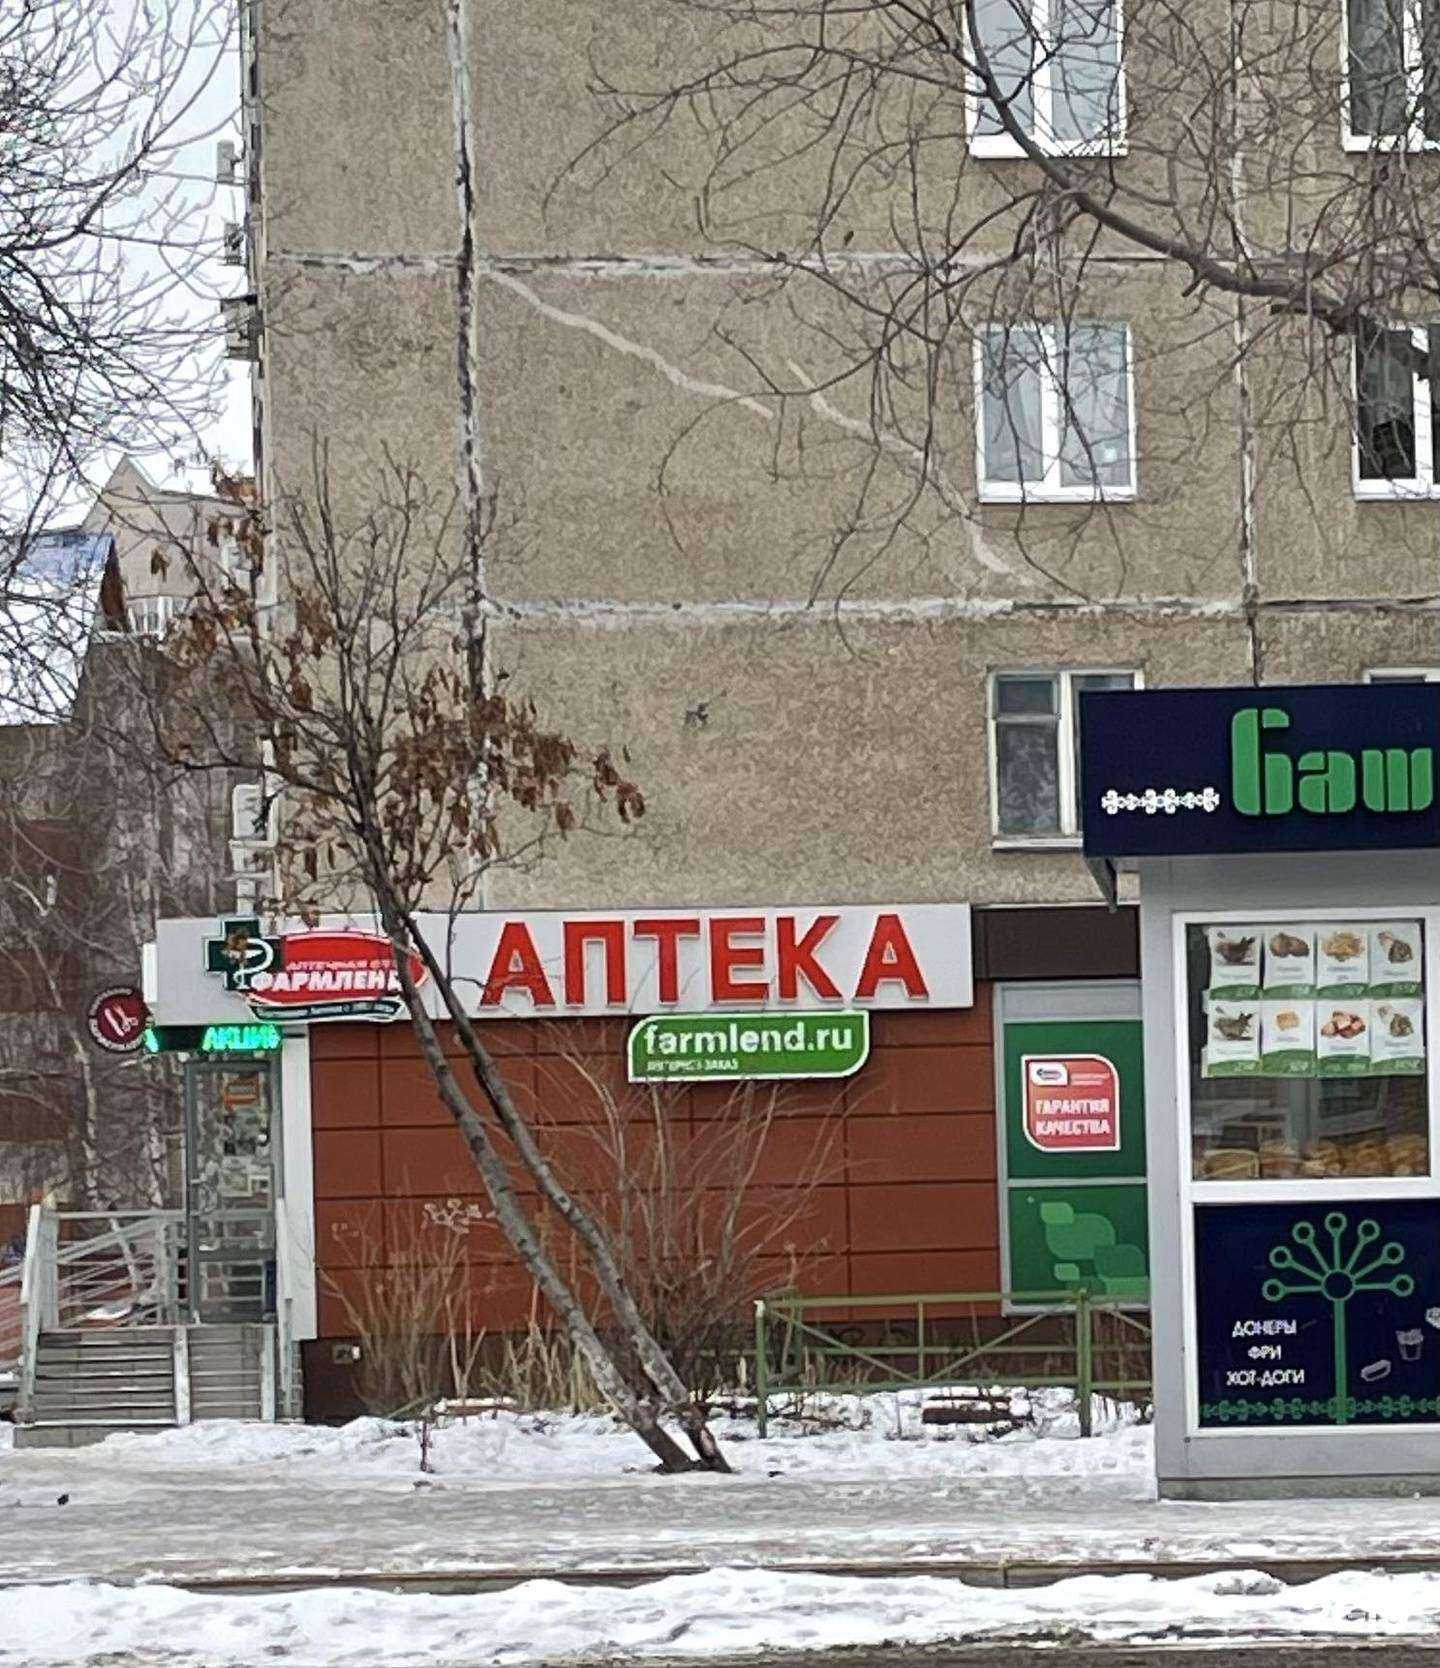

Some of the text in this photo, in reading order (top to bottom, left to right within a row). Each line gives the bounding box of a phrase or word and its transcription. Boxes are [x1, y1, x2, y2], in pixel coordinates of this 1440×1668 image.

[478, 912, 930, 1009] АПТЕКА
[643, 1021, 853, 1055] farmlend.ru
[1035, 1098, 1110, 1114] ГАРАНТИЯ
[1035, 1119, 1111, 1136] КАЧЕСТВА
[1247, 1344, 1282, 1361] ФРИ
[1226, 1368, 1305, 1388] ХОТ-ДОГИ
